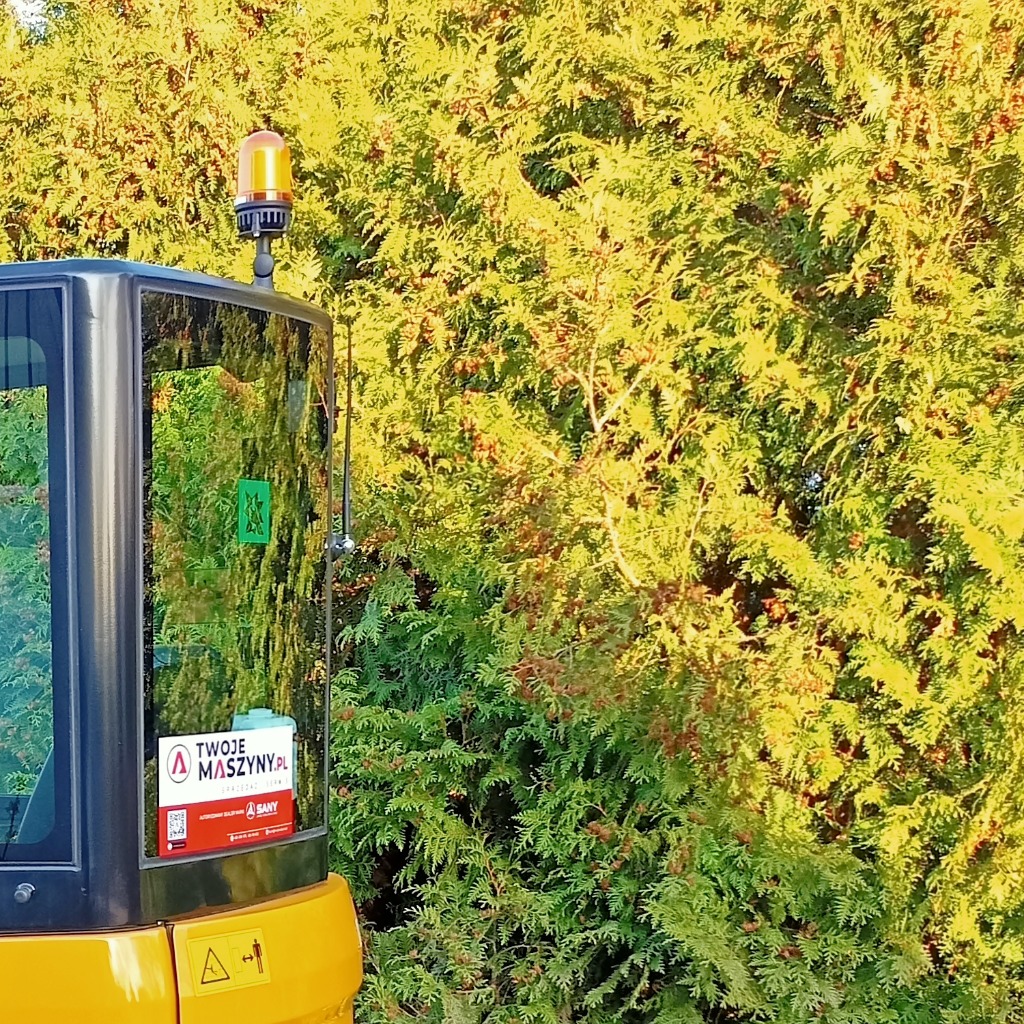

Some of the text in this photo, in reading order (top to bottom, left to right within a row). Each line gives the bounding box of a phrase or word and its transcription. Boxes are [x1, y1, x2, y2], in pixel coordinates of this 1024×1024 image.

[196, 738, 246, 758] TWOJE
[198, 753, 288, 781] MASZYNY.PL
[256, 801, 279, 814] SANY
